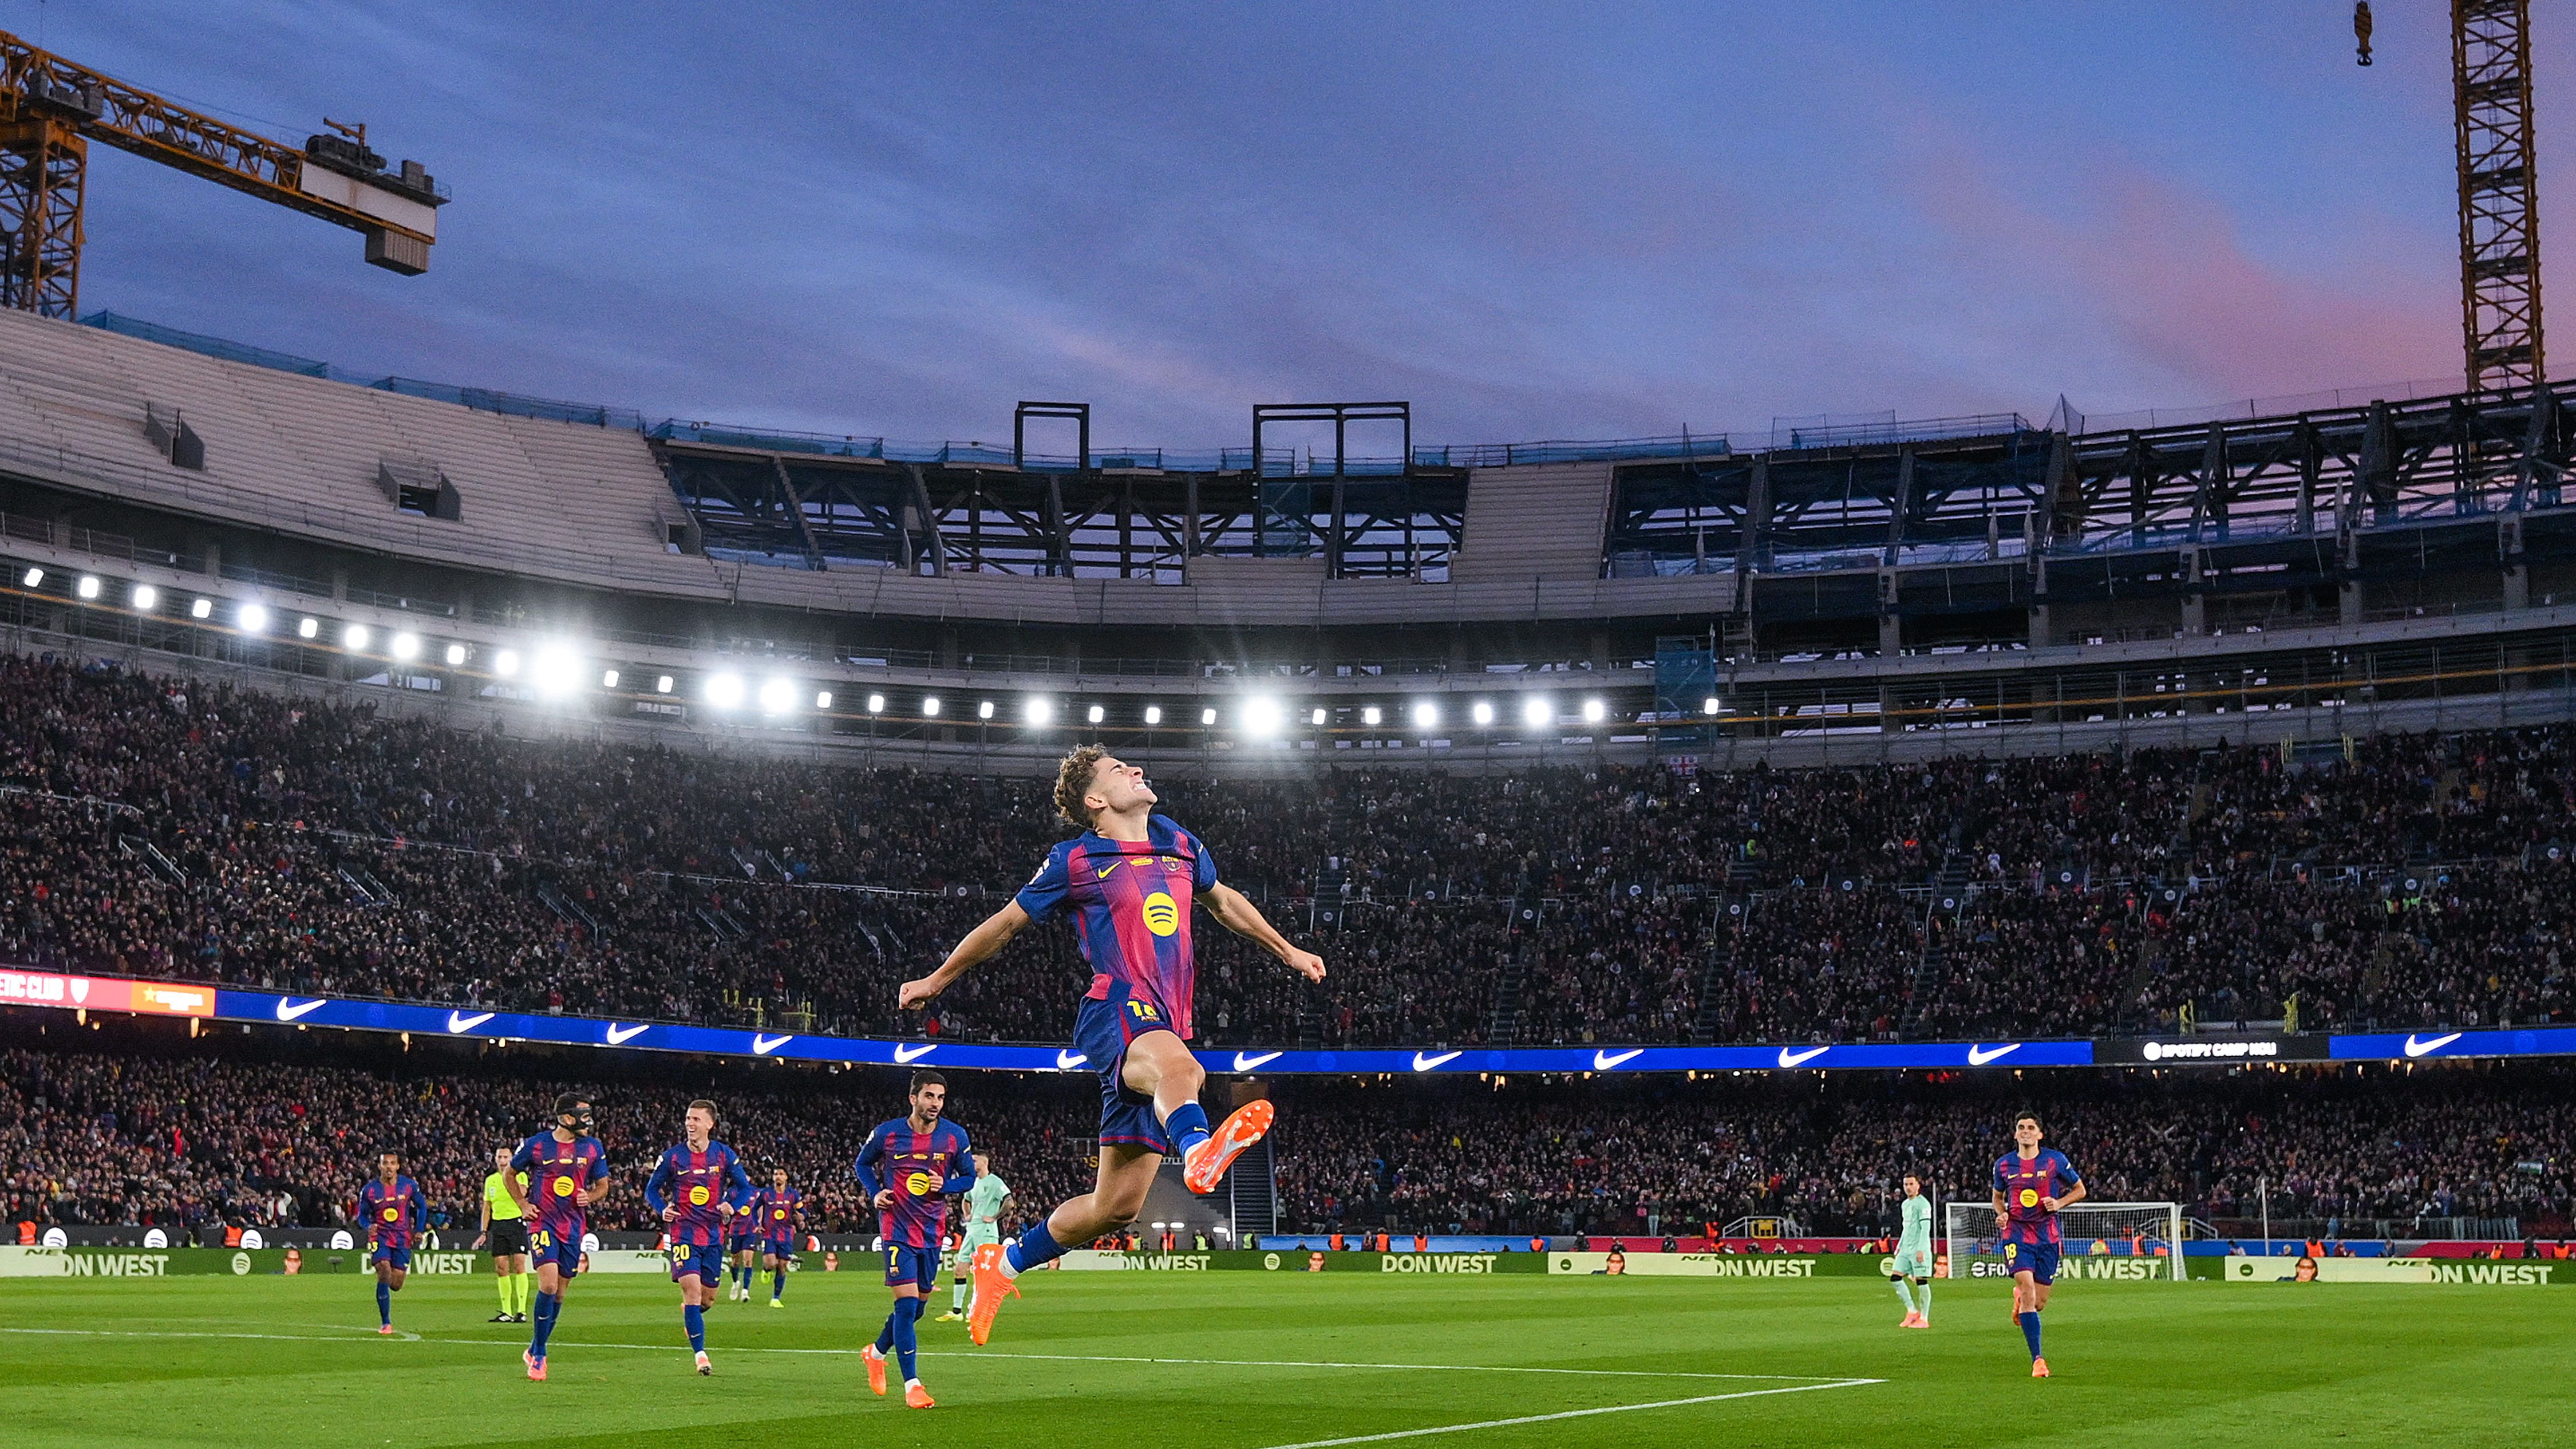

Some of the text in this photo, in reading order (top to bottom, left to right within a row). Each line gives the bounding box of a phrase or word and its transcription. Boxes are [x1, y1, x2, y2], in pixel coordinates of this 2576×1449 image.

[27, 976, 64, 1001] CLUB
[2162, 1044, 2212, 1057] SPOTIFY
[2212, 1043, 2249, 1057] CAMP
[531, 1230, 551, 1250] 24
[673, 1244, 690, 1262] 20
[888, 1246, 899, 1265] 7
[2004, 1243, 2017, 1260] 18
[97, 1254, 169, 1276] WEST
[414, 1253, 476, 1274] WEST
[1149, 1255, 1211, 1270] WEST
[1381, 1255, 1497, 1273] DON WEST
[1746, 1260, 1816, 1277] WEST
[2088, 1258, 2161, 1280] WEST
[2467, 1265, 2553, 1285] WEST
